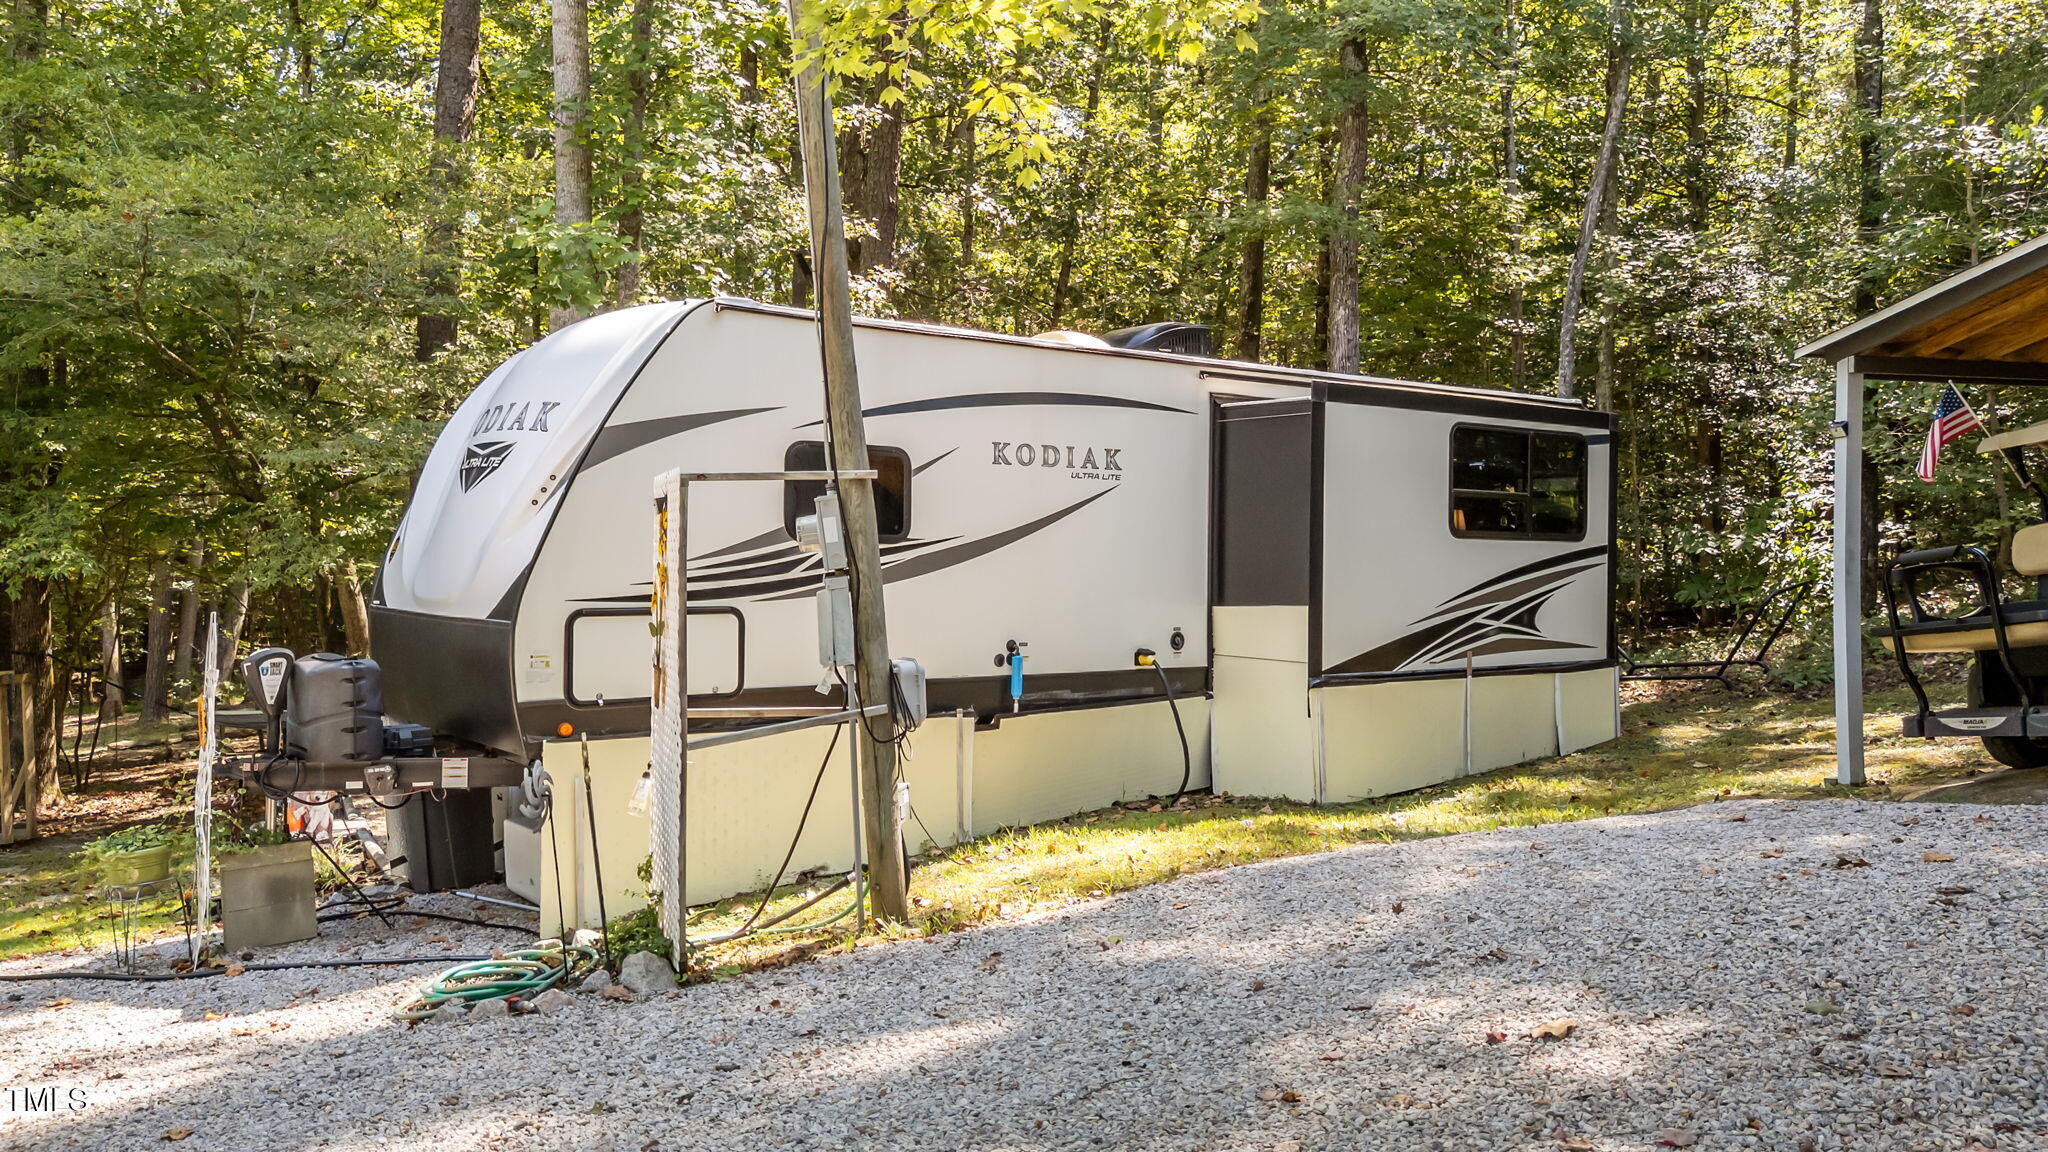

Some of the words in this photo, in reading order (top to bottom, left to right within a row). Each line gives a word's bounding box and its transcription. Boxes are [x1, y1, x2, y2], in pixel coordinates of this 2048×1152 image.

[472, 401, 561, 437] ODIAK
[481, 456, 502, 468] LITE
[991, 441, 1122, 471] KODIAK
[1071, 472, 1100, 480] ULTRA
[1102, 473, 1122, 481] LITE
